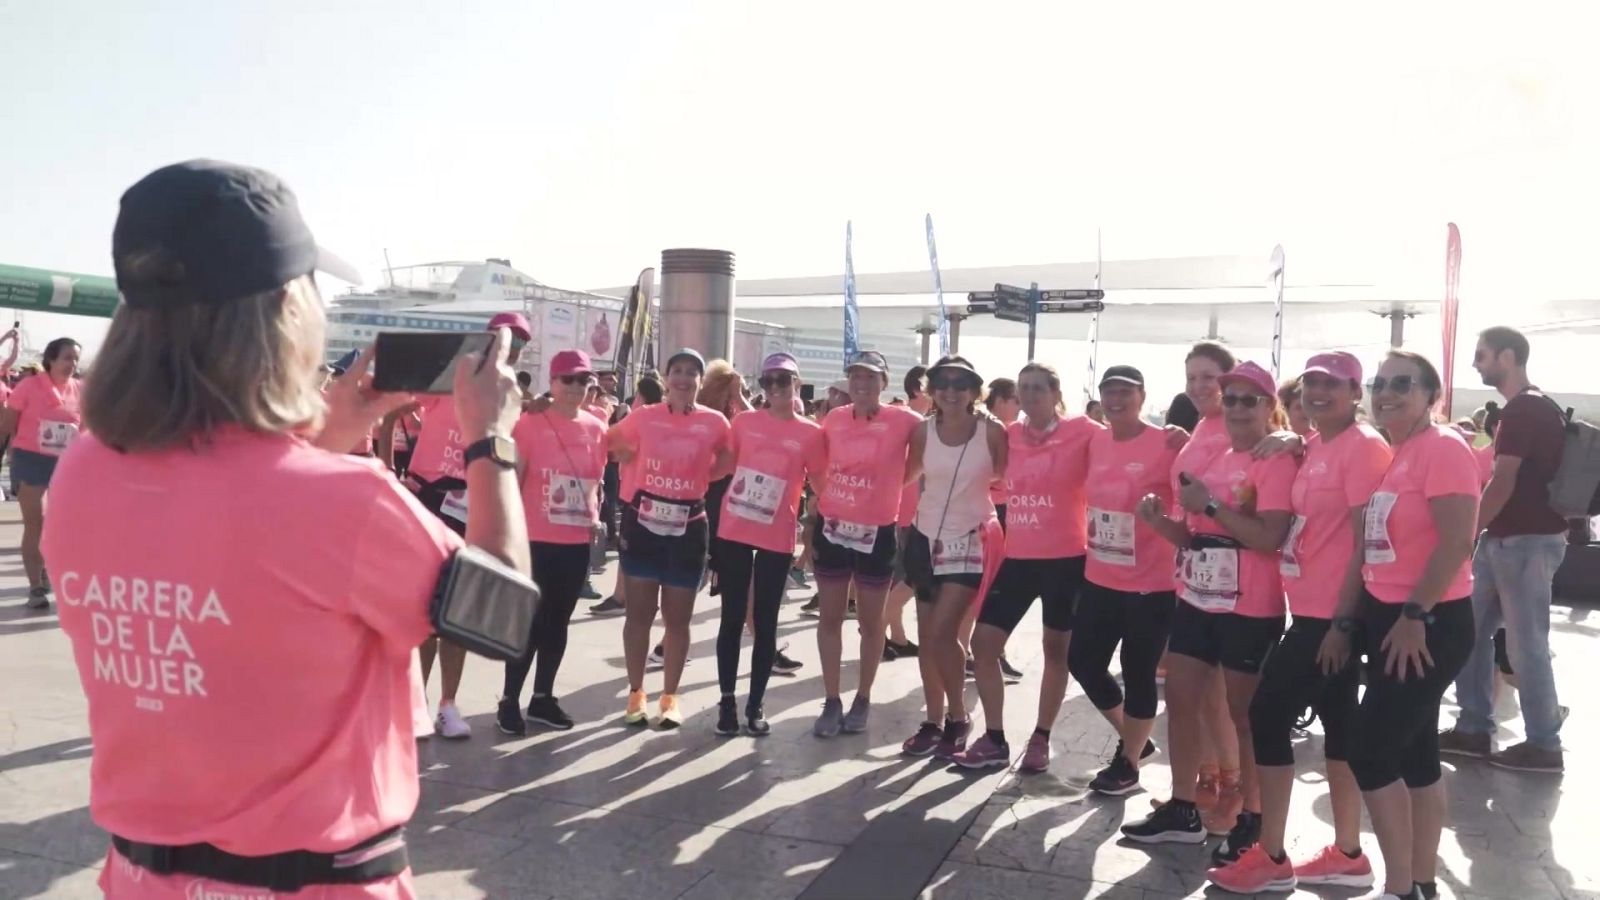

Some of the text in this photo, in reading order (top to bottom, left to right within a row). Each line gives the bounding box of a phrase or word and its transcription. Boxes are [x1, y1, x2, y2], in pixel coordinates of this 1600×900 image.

[60, 571, 231, 625] CARRERA
[91, 612, 196, 659] DE LA
[93, 648, 207, 697] MUJER
